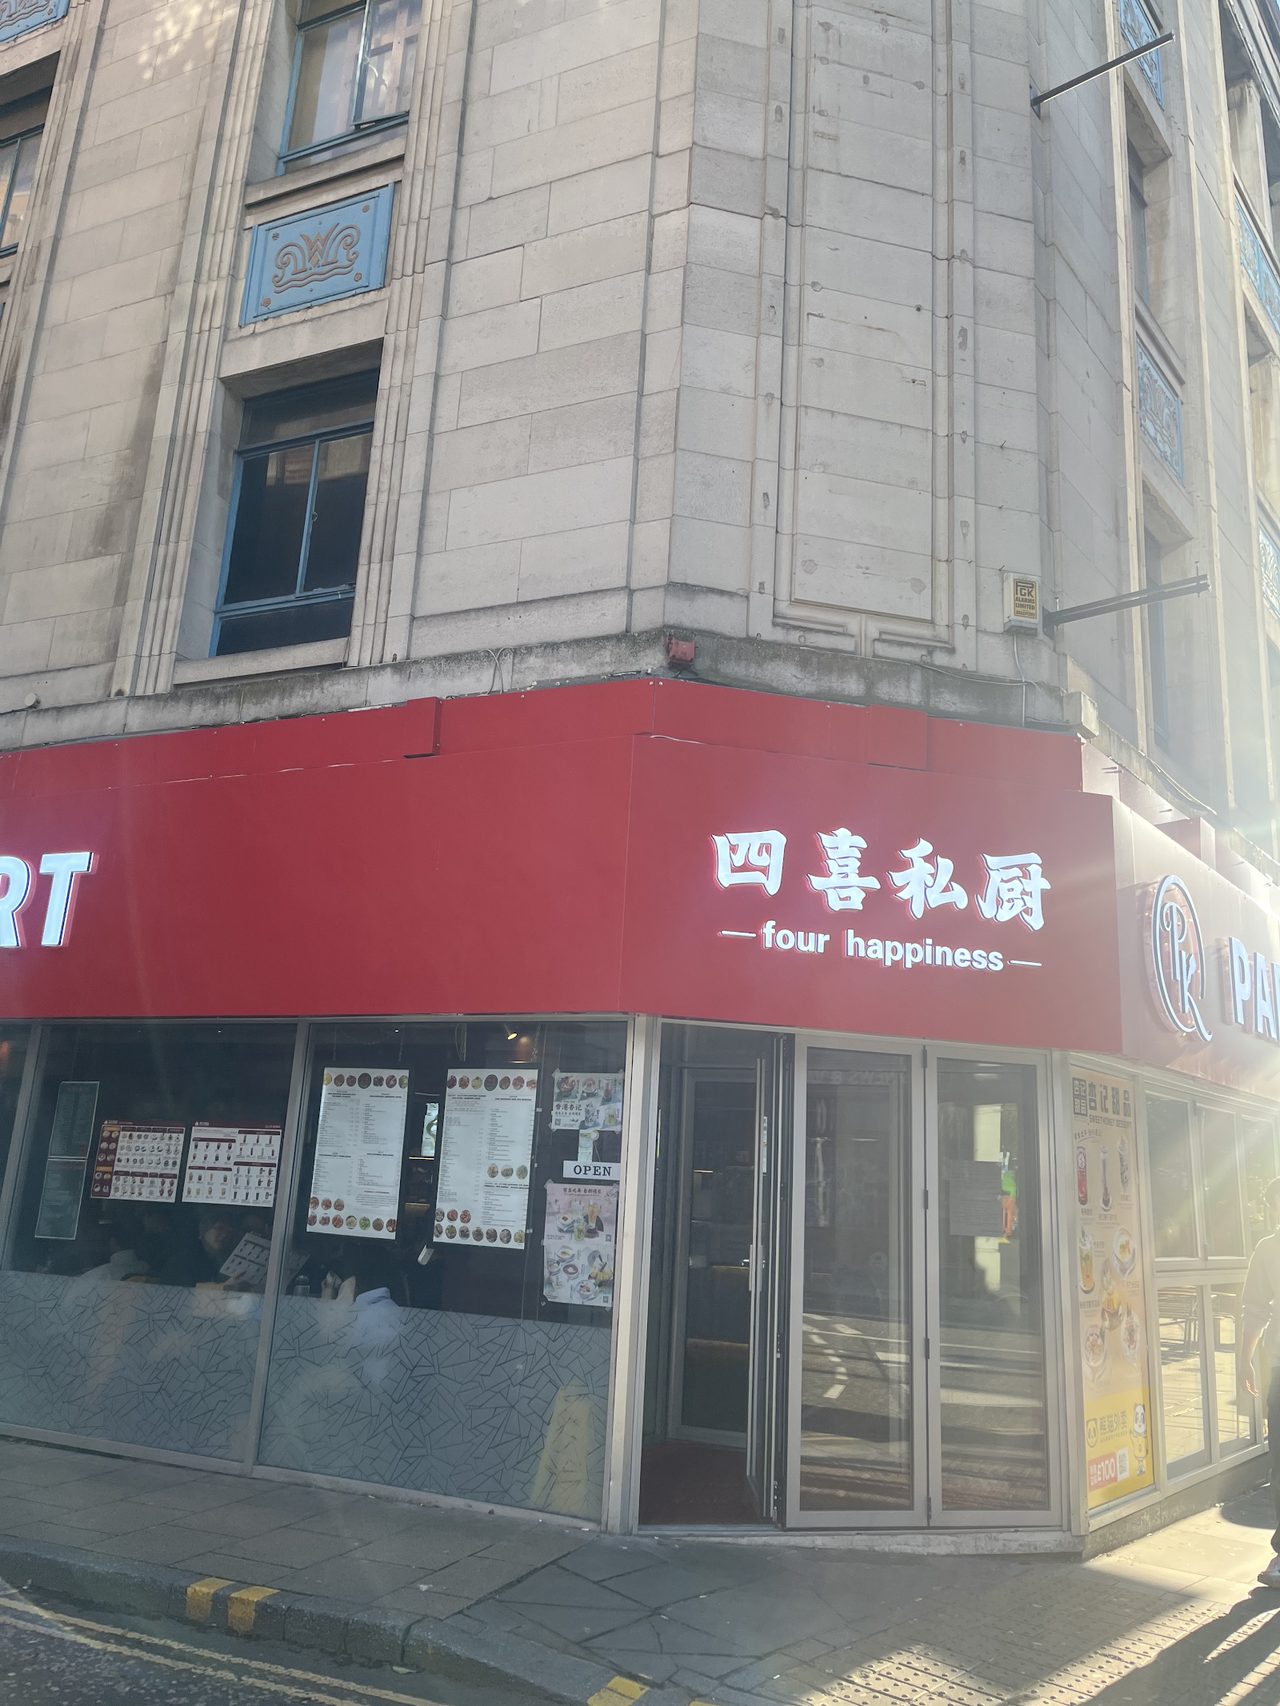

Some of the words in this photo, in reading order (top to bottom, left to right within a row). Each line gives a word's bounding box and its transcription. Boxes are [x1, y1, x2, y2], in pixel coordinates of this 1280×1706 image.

[710, 827, 1052, 931] 四喜私厨
[762, 920, 830, 953] four
[846, 929, 1004, 971] happiness
[573, 1164, 612, 1176] OPEN
